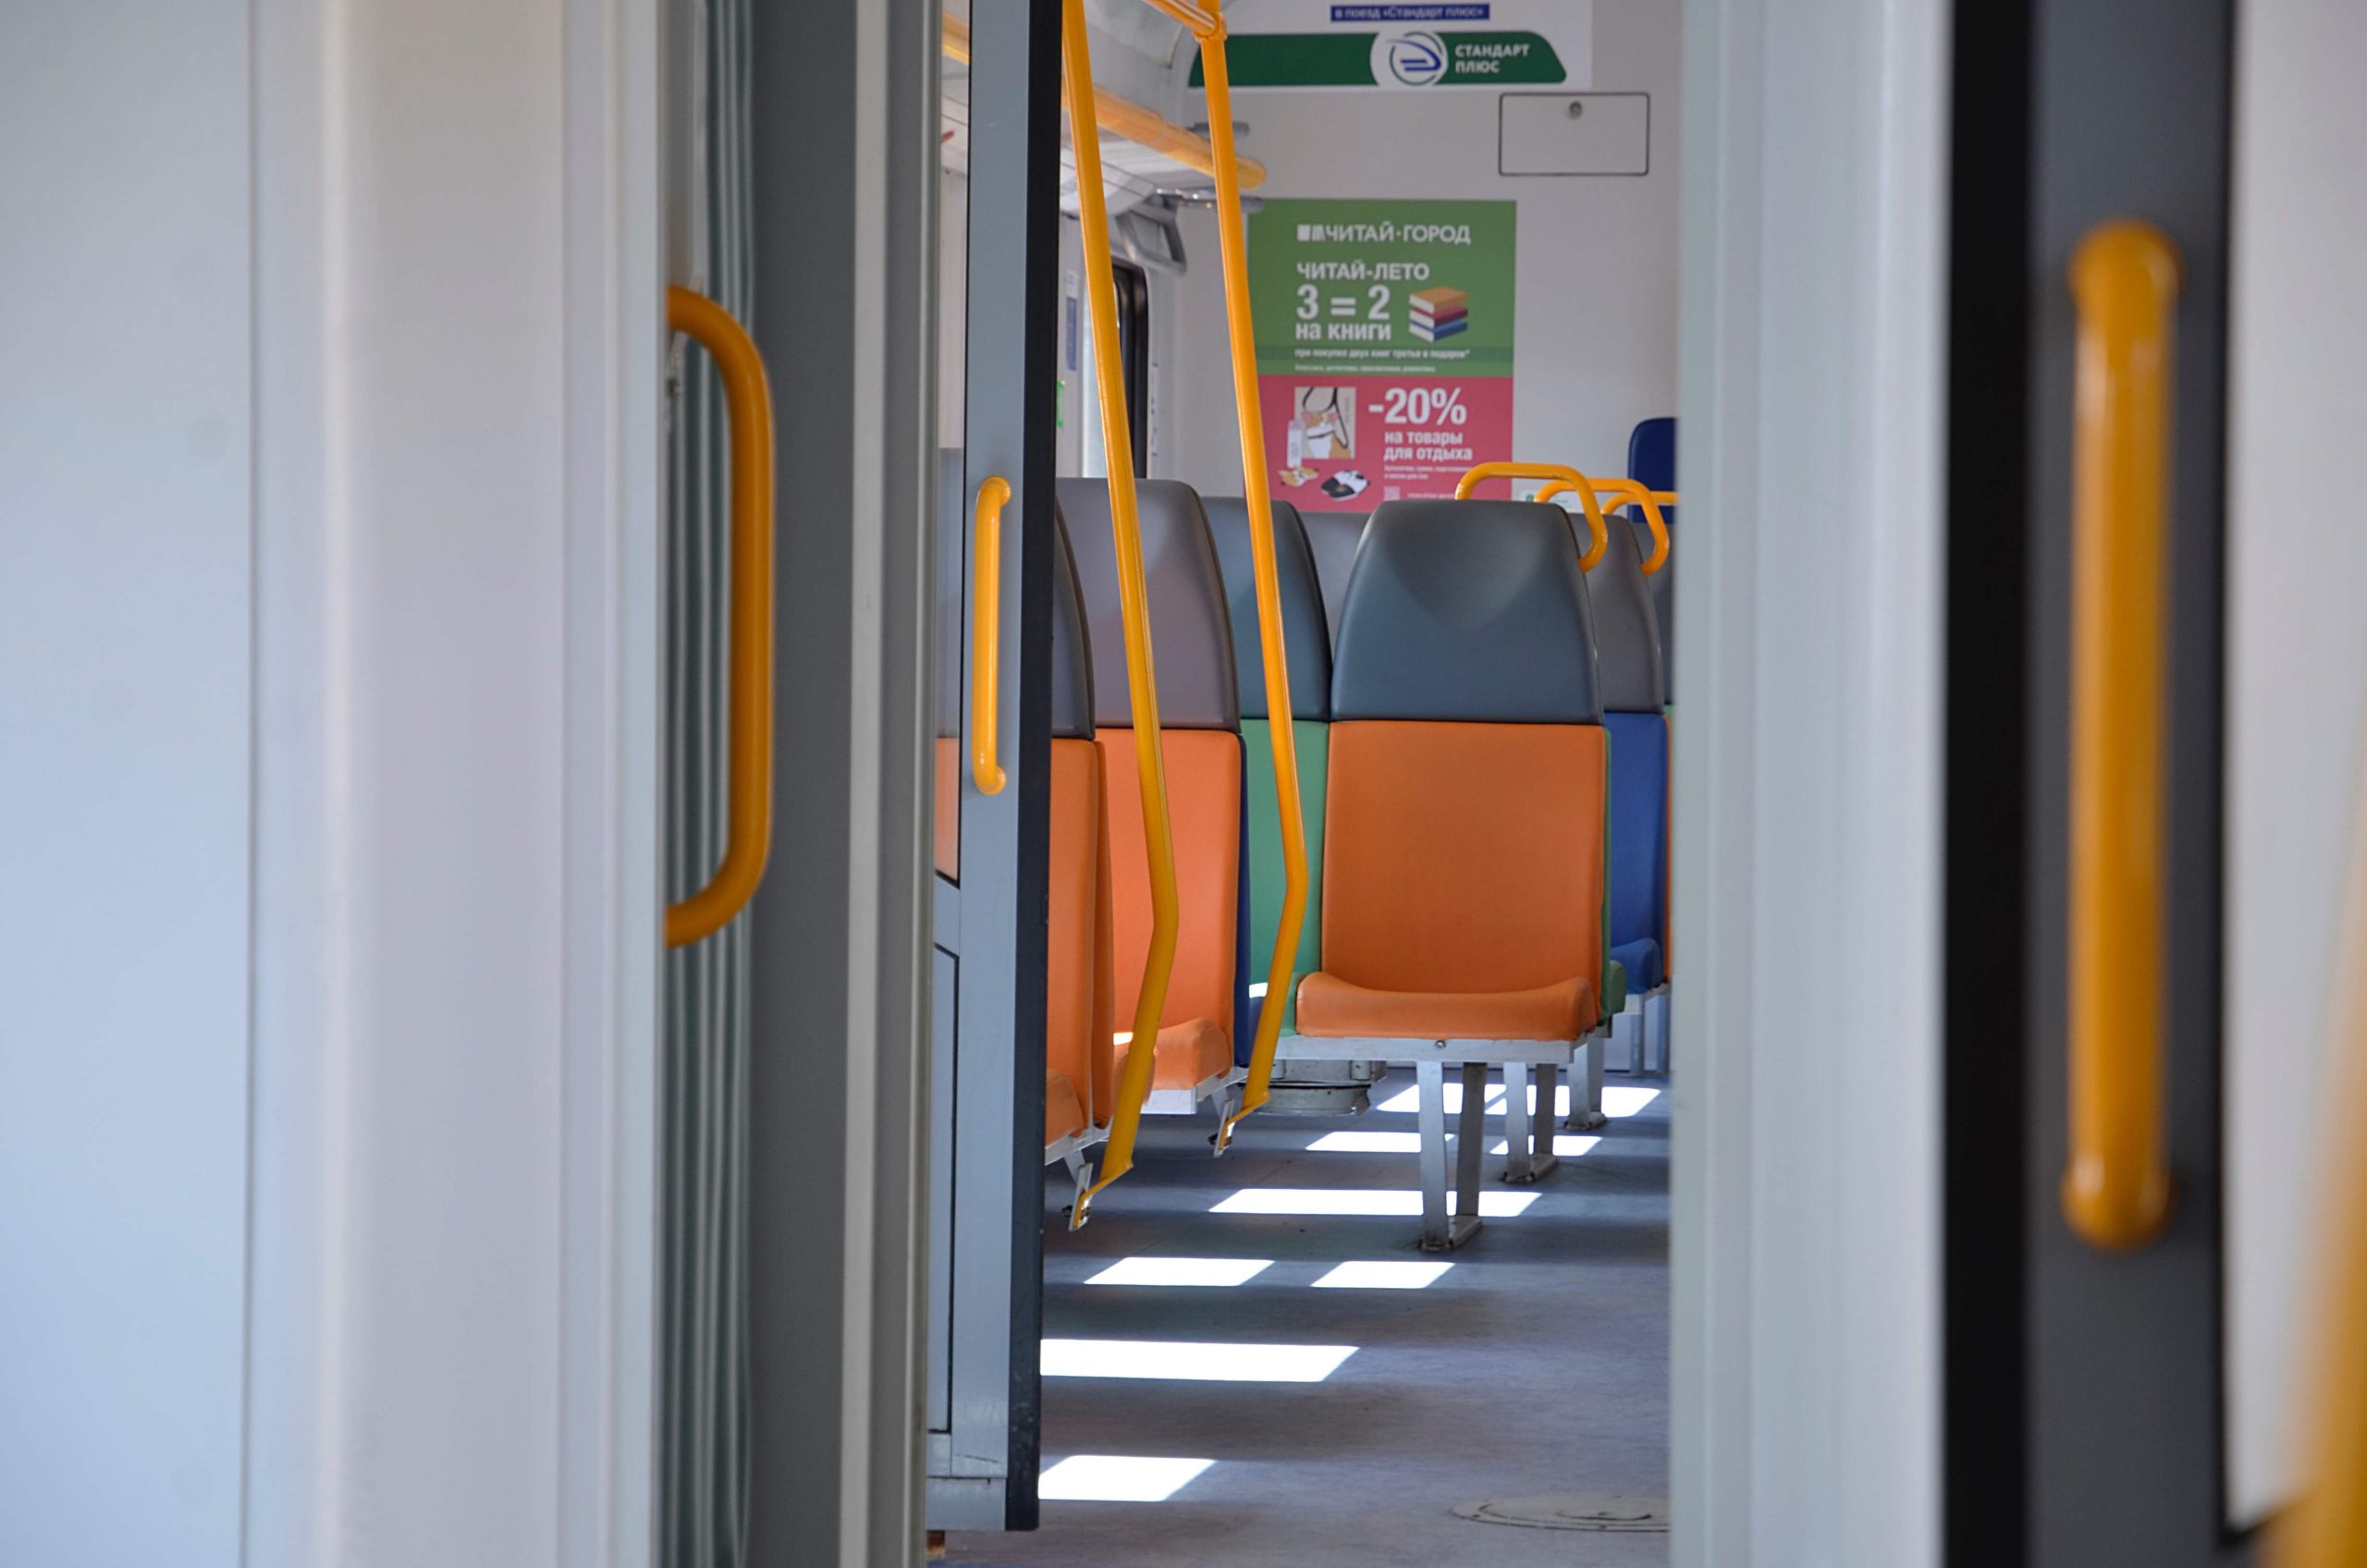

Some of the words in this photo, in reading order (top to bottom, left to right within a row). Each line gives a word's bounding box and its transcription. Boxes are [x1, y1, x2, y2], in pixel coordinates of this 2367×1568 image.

[1454, 43, 1530, 58] СТАНДАРТ
[1454, 59, 1500, 74] ПЛЮС
[1296, 259, 1429, 281] ЧИТАЙ-ЛЕТО
[1296, 284, 1319, 320] 3
[1367, 284, 1391, 320] 2
[1295, 324, 1321, 340] на
[1328, 324, 1392, 341] книги
[1368, 386, 1467, 426] -20%
[1384, 432, 1403, 445] на
[1406, 432, 1463, 447] товары
[1383, 447, 1412, 461] для
[1416, 447, 1473, 462] отдыха
